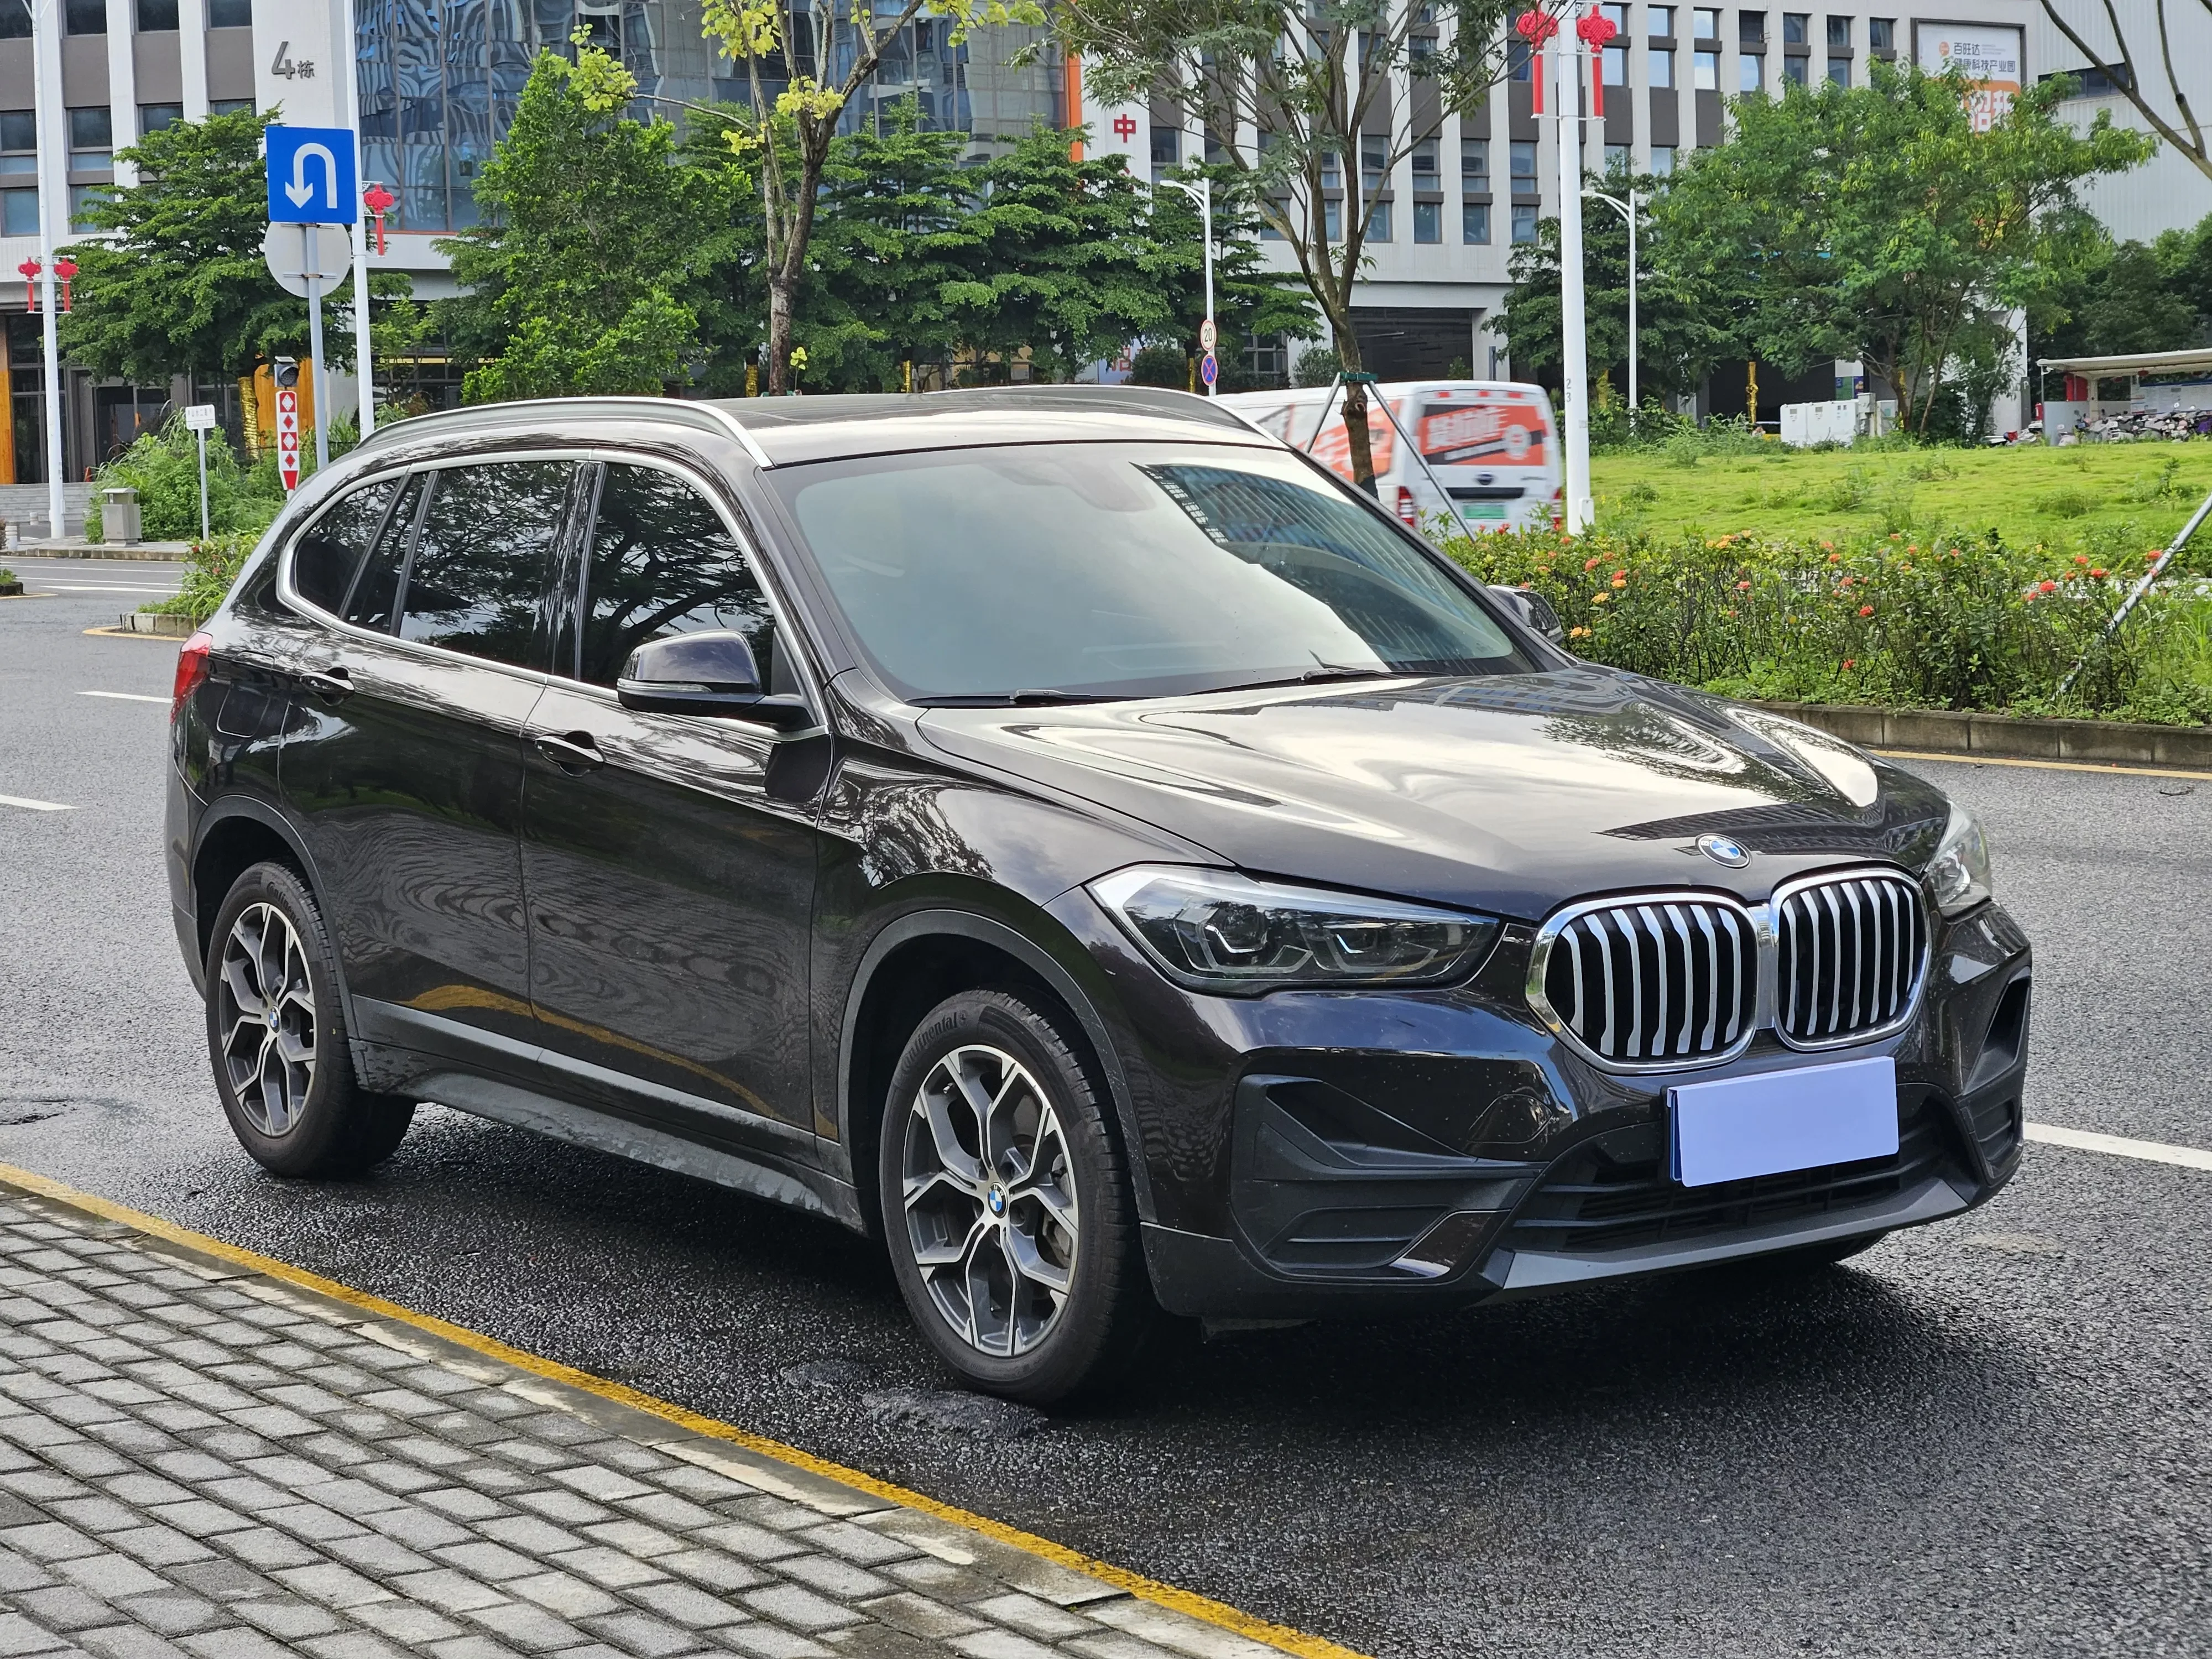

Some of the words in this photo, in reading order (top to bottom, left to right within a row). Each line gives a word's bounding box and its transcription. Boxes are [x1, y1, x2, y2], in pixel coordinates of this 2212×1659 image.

[1954, 42, 1980, 55] 百旺达
[272, 41, 315, 79] 4栋
[1204, 328, 1212, 342] 20
